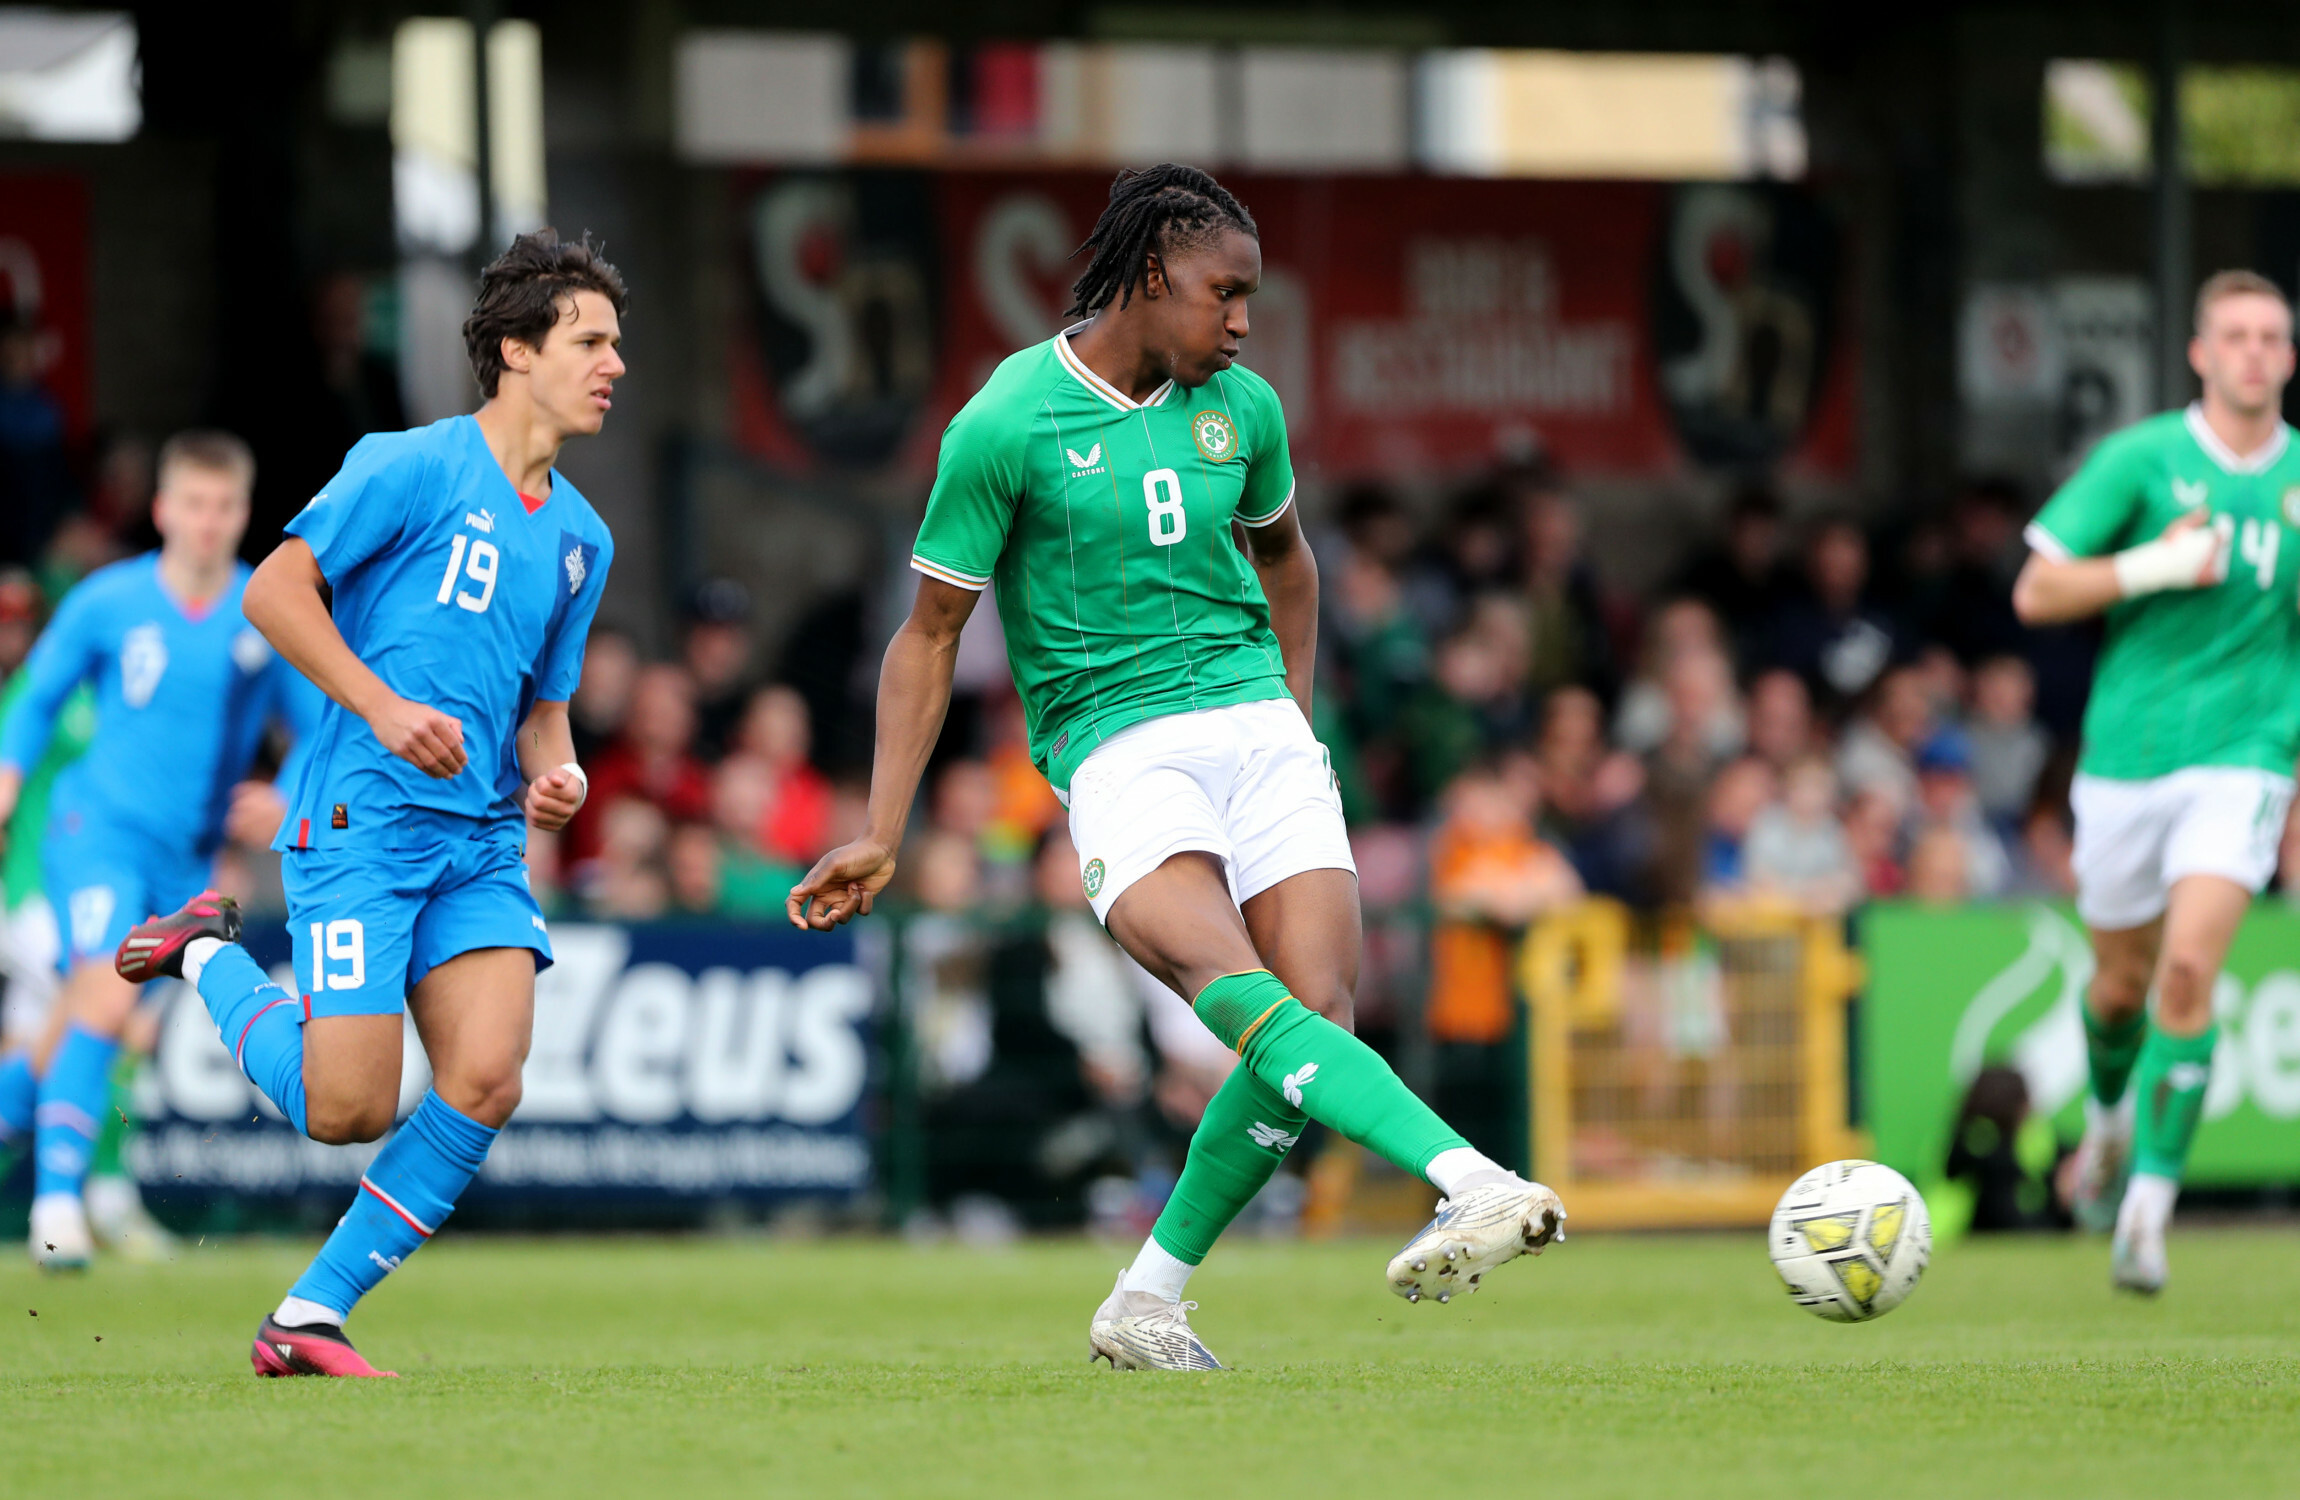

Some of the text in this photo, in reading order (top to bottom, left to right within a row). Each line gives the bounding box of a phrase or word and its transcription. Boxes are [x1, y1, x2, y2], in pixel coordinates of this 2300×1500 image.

[1195, 414, 1230, 431] IRELAND
[1071, 466, 1106, 478] CASTORE
[465, 512, 490, 534] PUMA
[1142, 467, 1187, 547] 8
[436, 533, 499, 614] 19
[310, 918, 366, 992] 19
